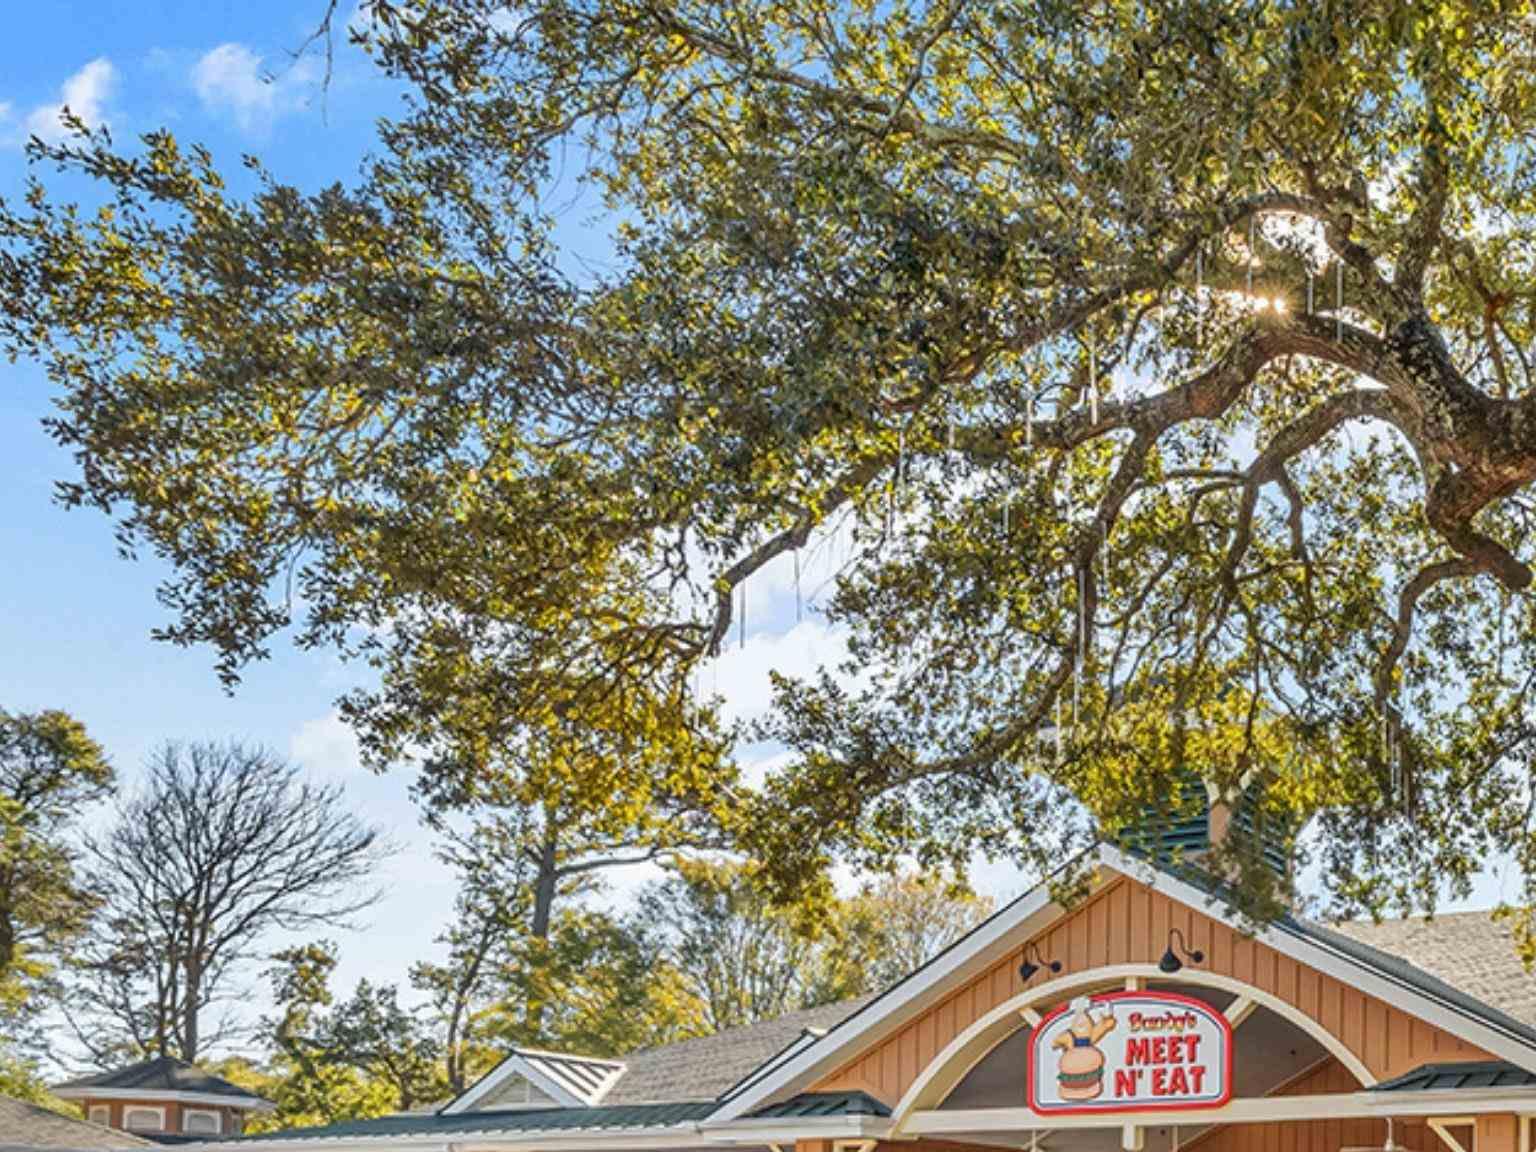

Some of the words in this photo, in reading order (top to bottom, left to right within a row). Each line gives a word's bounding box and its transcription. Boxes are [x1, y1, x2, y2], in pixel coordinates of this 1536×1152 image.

[1125, 1035, 1201, 1066] MEET
[1114, 1069, 1144, 1098] N'
[1151, 1066, 1206, 1096] EAT
